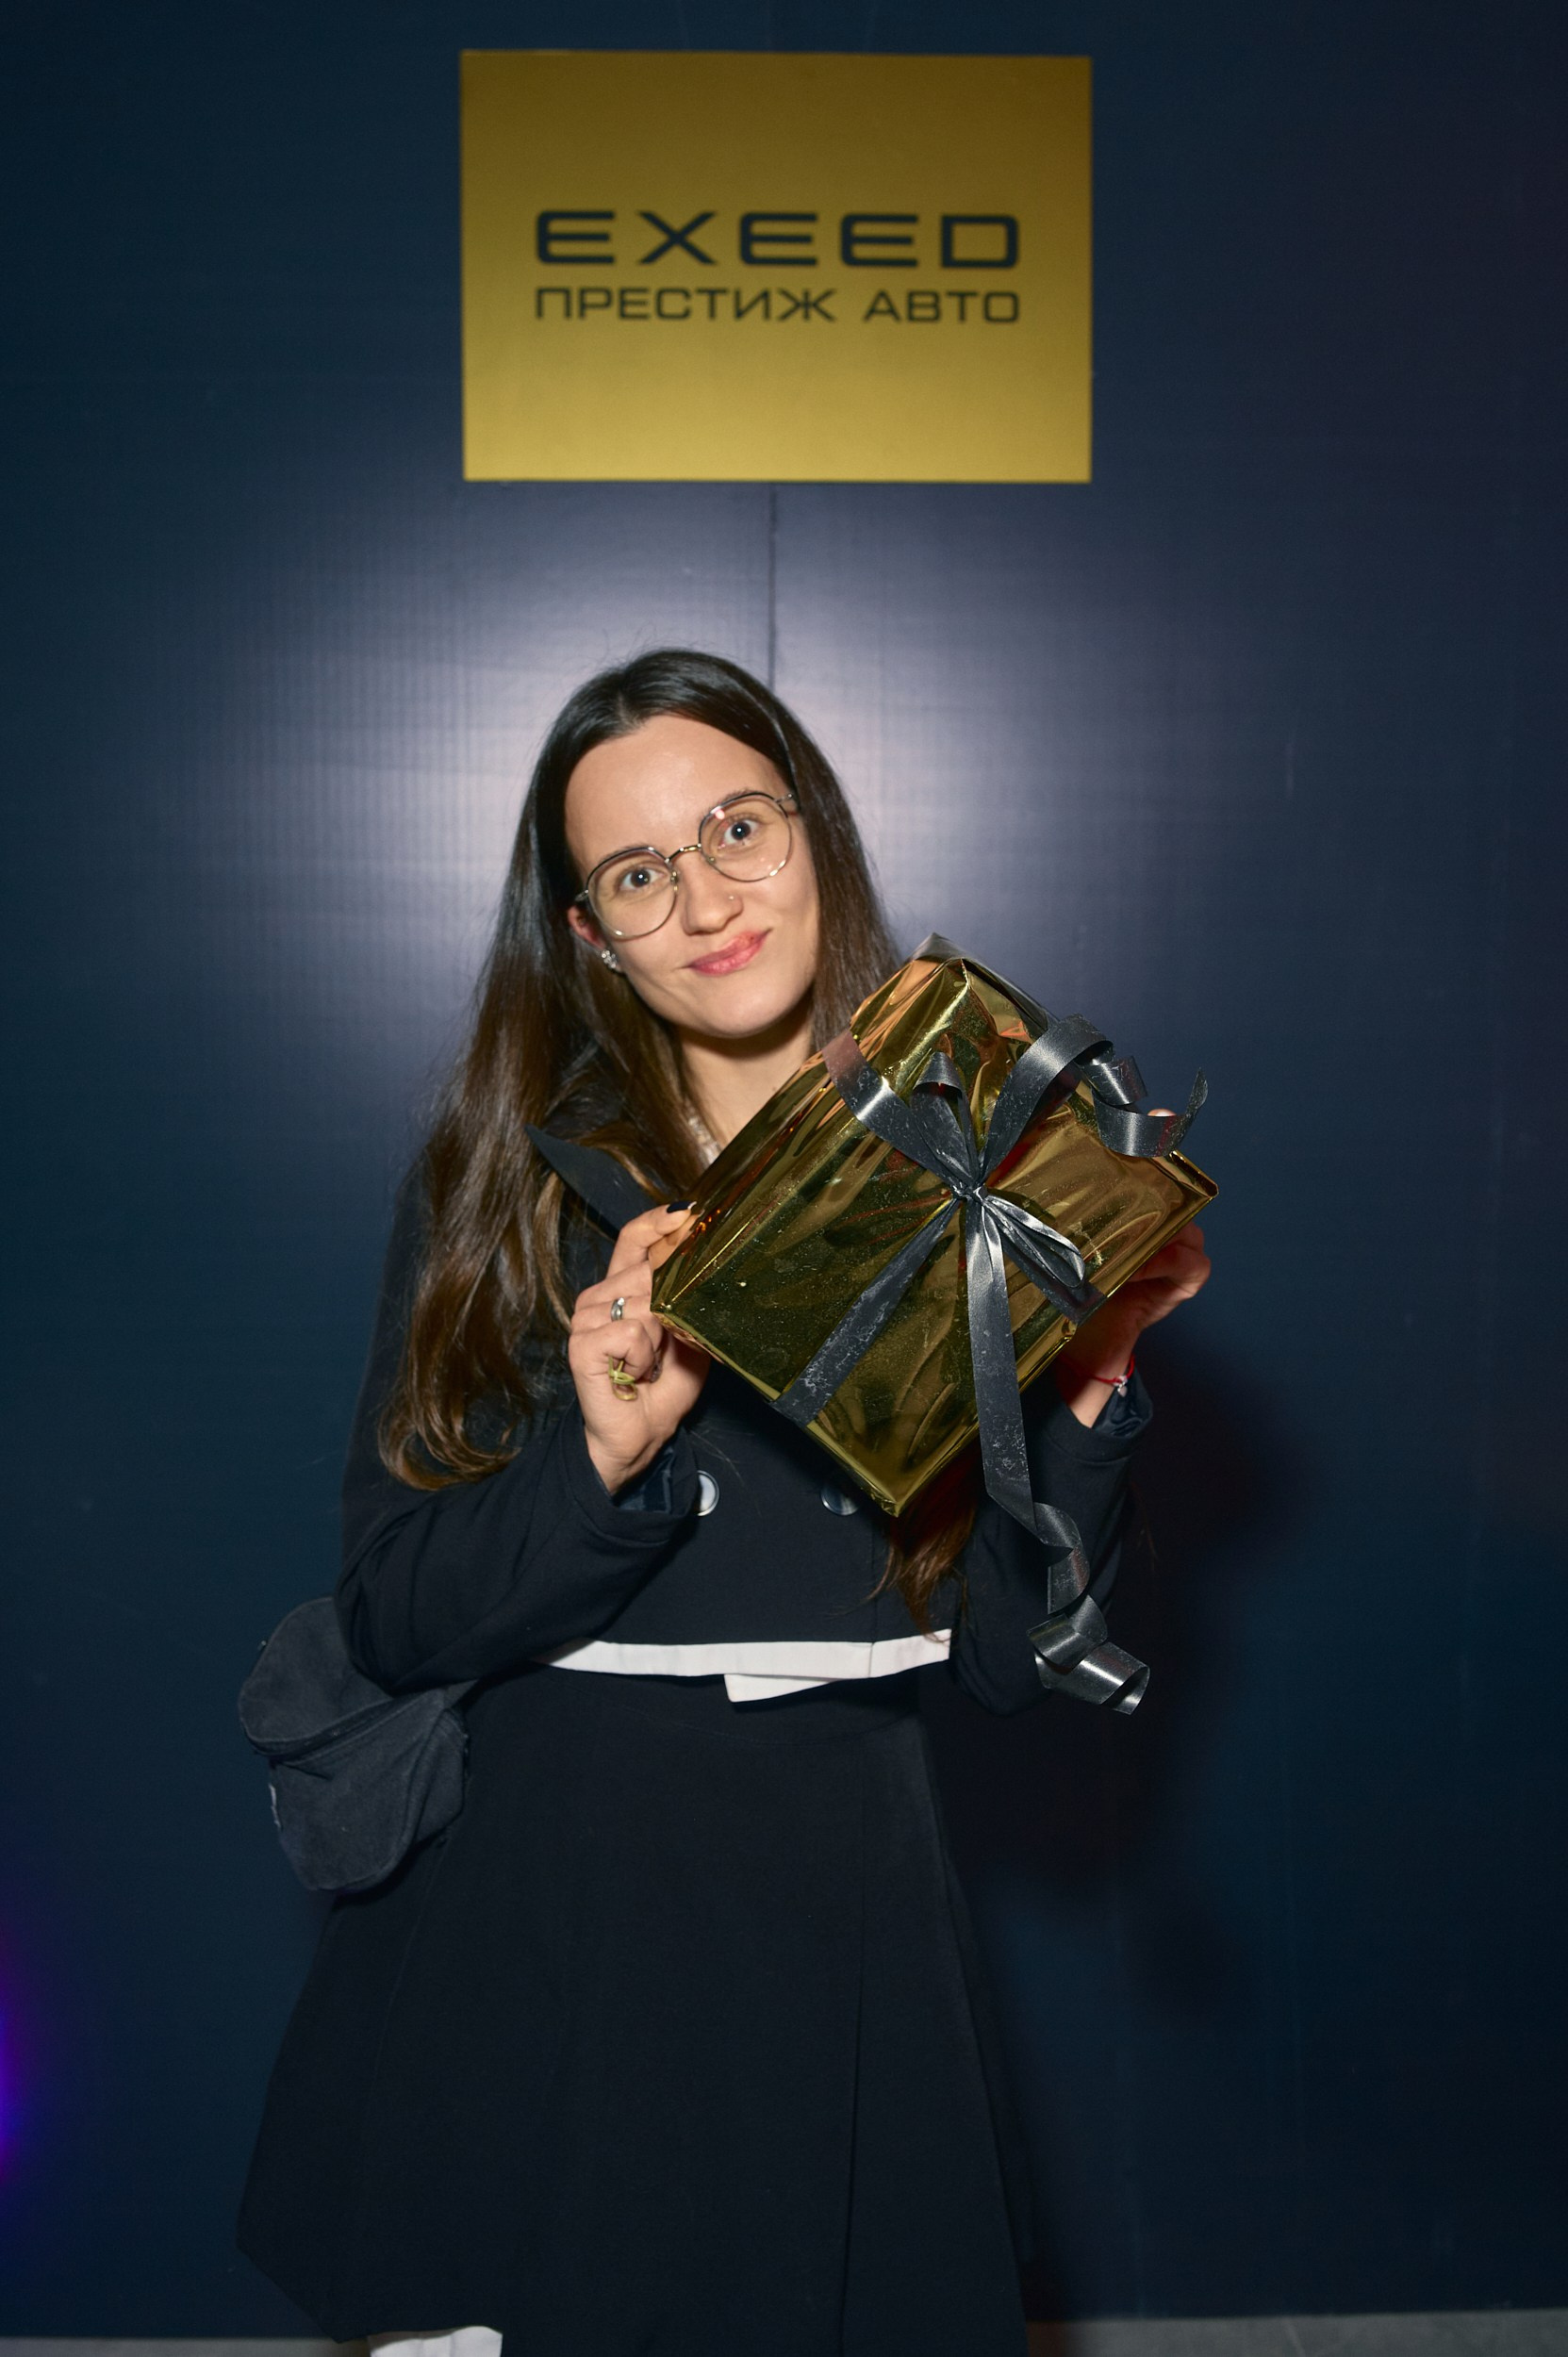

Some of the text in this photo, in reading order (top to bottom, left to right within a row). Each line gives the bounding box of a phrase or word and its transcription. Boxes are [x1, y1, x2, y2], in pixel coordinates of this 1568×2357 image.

[536, 209, 1019, 270] EXEED
[535, 287, 1019, 324] ПРЕСТИЖ АВТО
